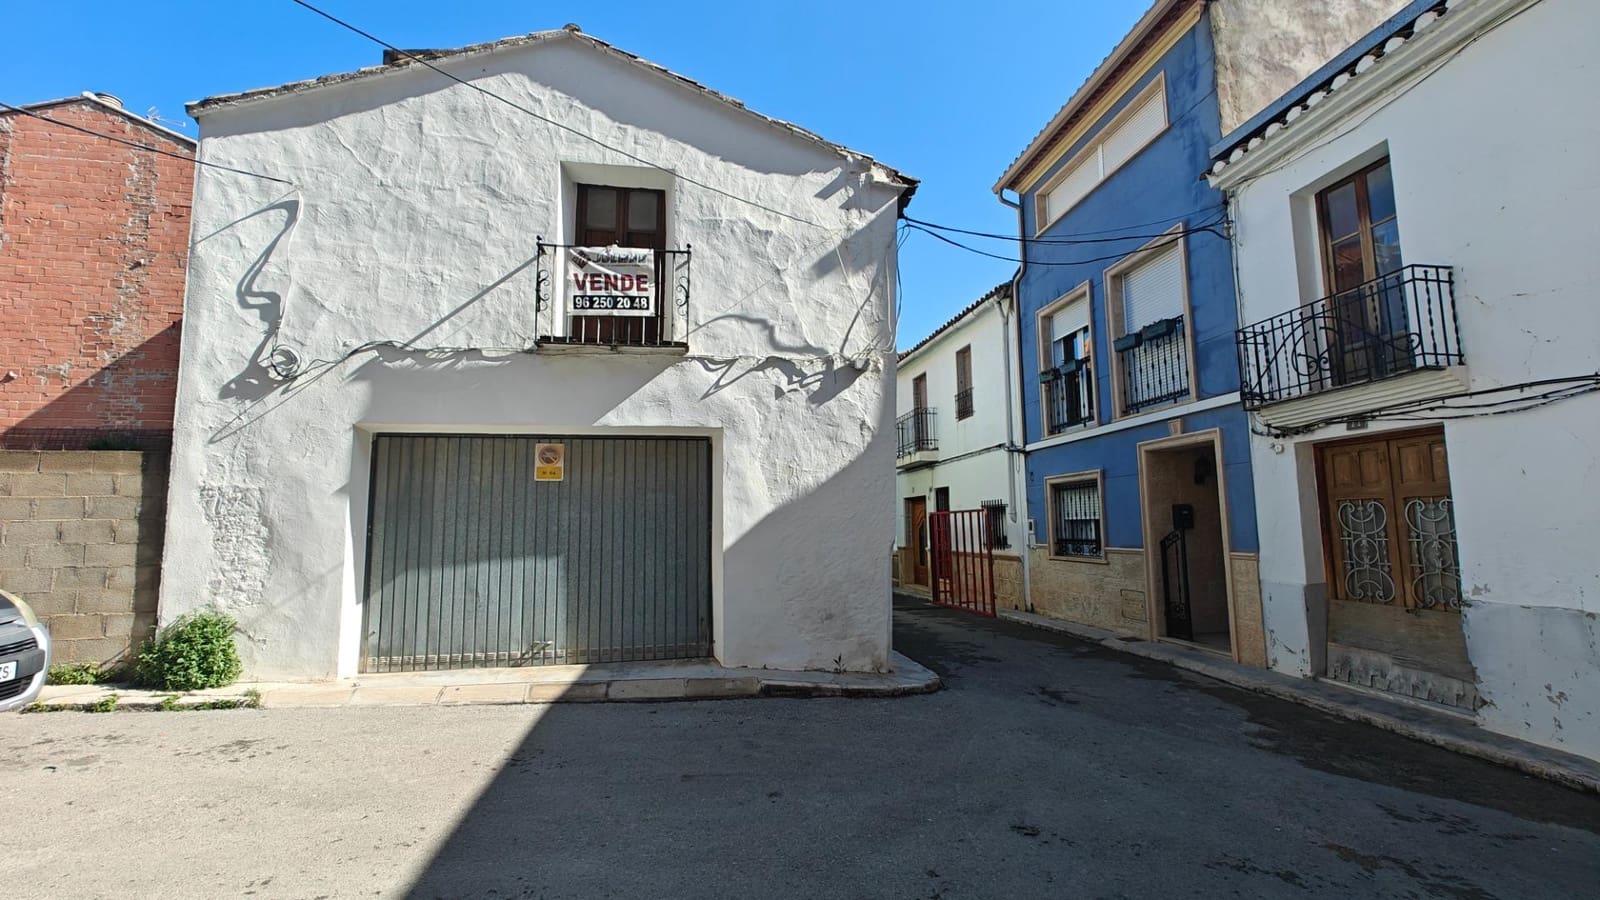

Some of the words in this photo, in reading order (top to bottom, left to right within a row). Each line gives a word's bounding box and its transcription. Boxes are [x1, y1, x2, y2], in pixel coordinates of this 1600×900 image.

[573, 272, 649, 292] VENDE
[575, 296, 590, 309] 96
[592, 296, 614, 309] 250
[616, 296, 631, 309] 20
[633, 297, 648, 309] 48
